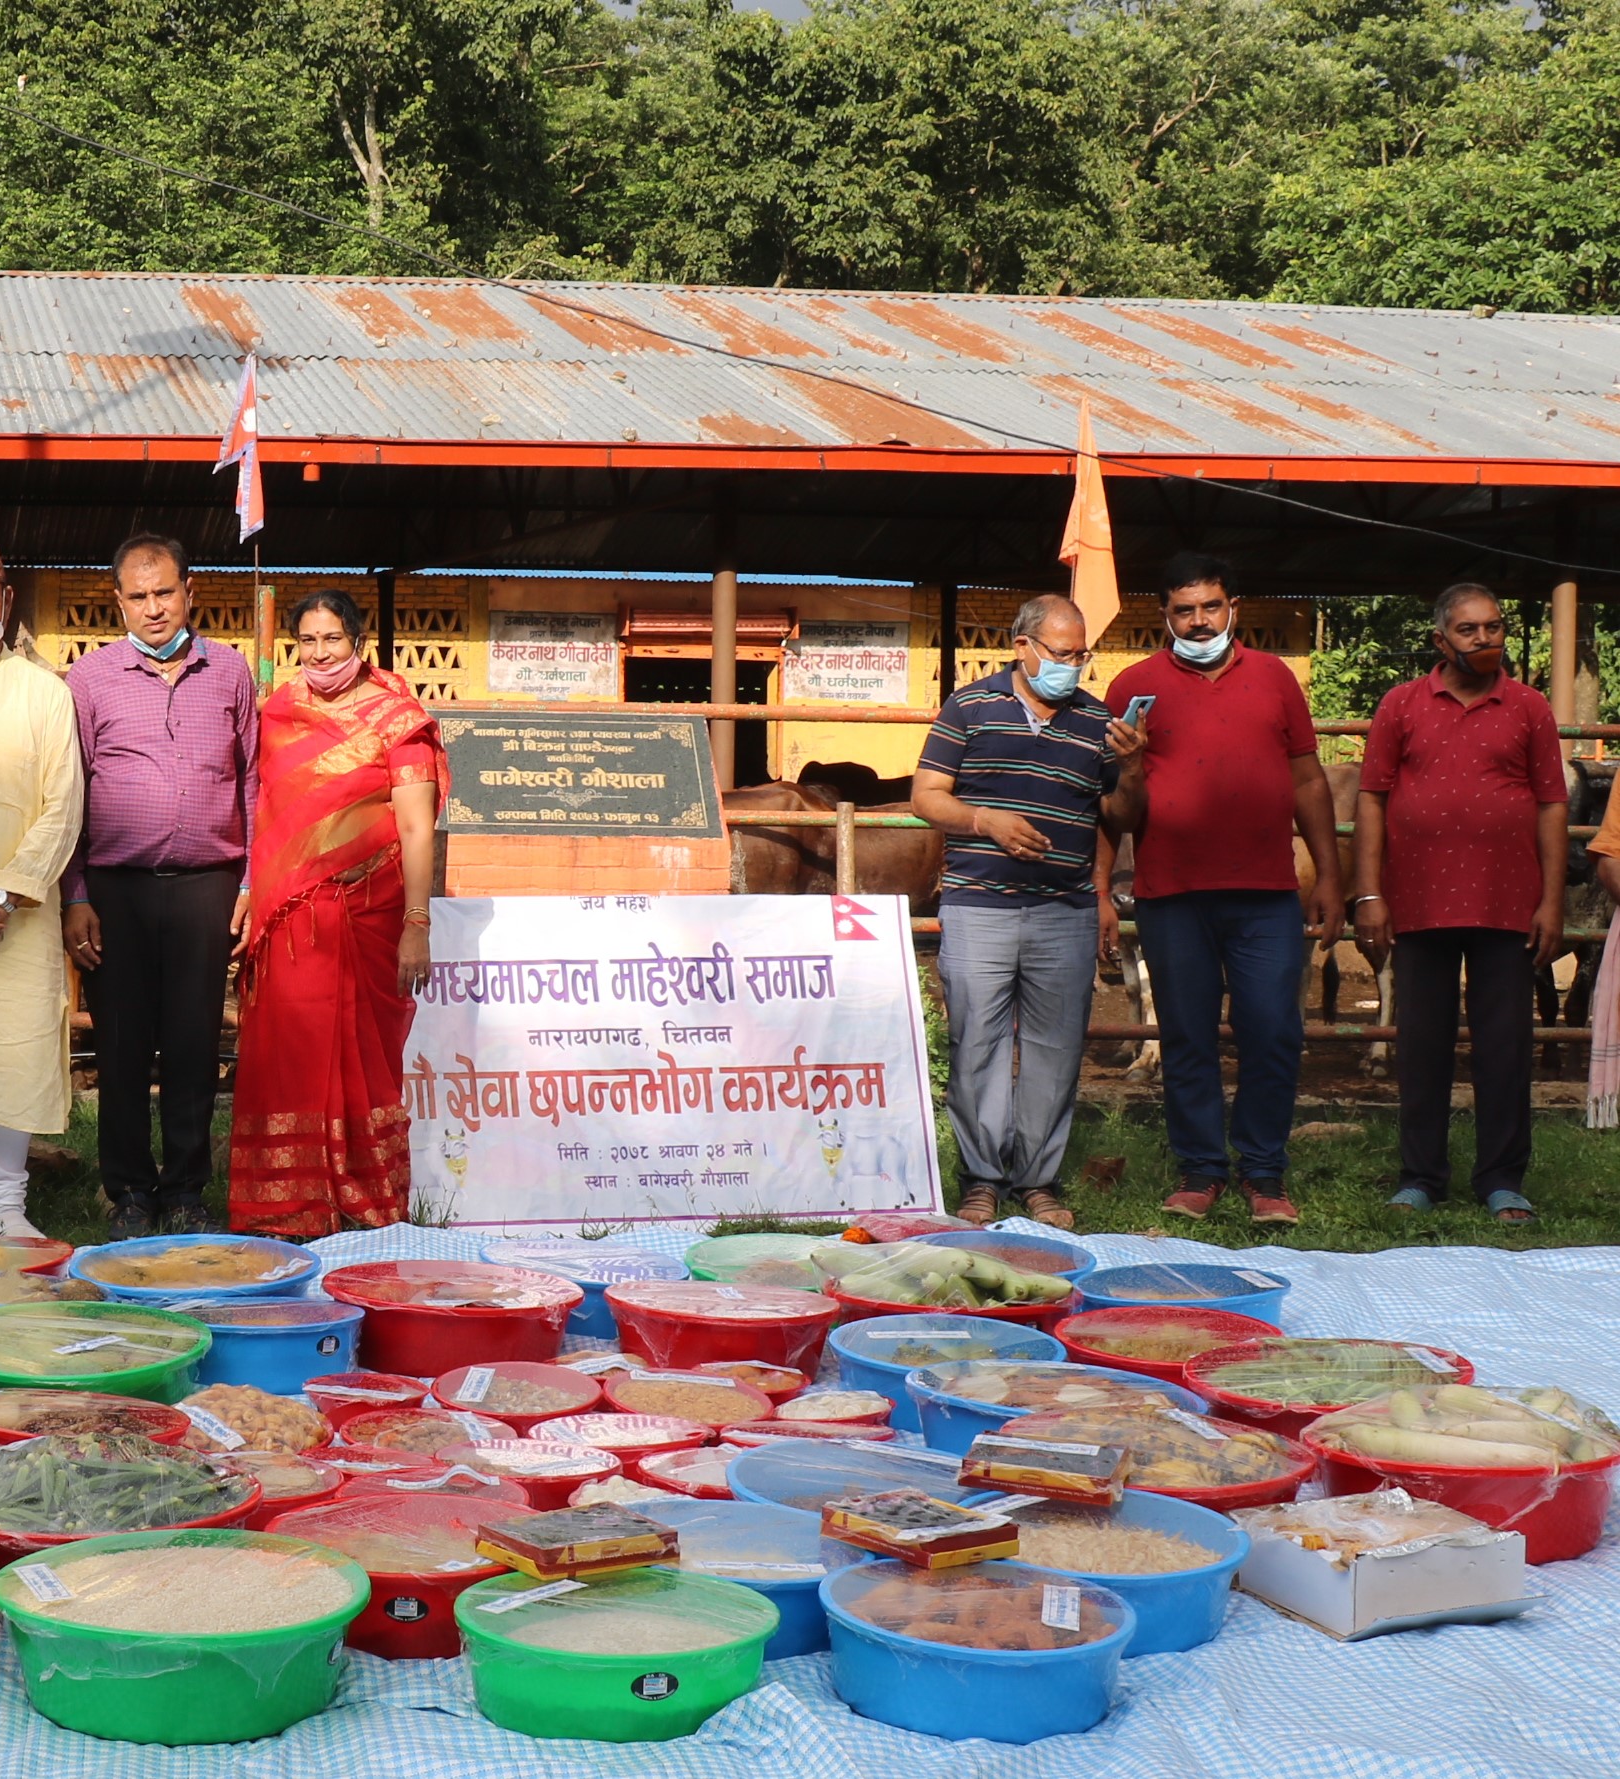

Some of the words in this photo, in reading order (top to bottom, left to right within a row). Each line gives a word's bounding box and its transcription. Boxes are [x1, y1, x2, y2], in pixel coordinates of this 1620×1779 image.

[570, 615, 602, 628] नेपाल
[865, 623, 896, 637] नेपाल
[502, 739, 520, 752] श्री
[479, 765, 574, 788] बागेश्वरी
[580, 767, 666, 790] गौशाला
[539, 808, 567, 821] मिति
[423, 959, 599, 1007] मध्यमाञ्चल
[609, 941, 735, 1008] माहेश्वरी
[744, 954, 837, 1004] समाज
[661, 1020, 734, 1045] चितवन
[403, 1051, 437, 1120] गौ
[443, 1052, 521, 1133] सेवा
[526, 1050, 714, 1128] छपन्नभोग
[719, 1044, 888, 1116] कार्यक्रम
[557, 1142, 589, 1161] मिति
[611, 1144, 650, 1164] २०७८
[659, 1143, 700, 1160] श्रावण
[706, 1143, 726, 1162] २४
[733, 1139, 754, 1158] गते
[584, 1174, 618, 1191] स्थान
[638, 1168, 694, 1192] बागेश्वरी
[700, 1167, 750, 1188] गौशाला
